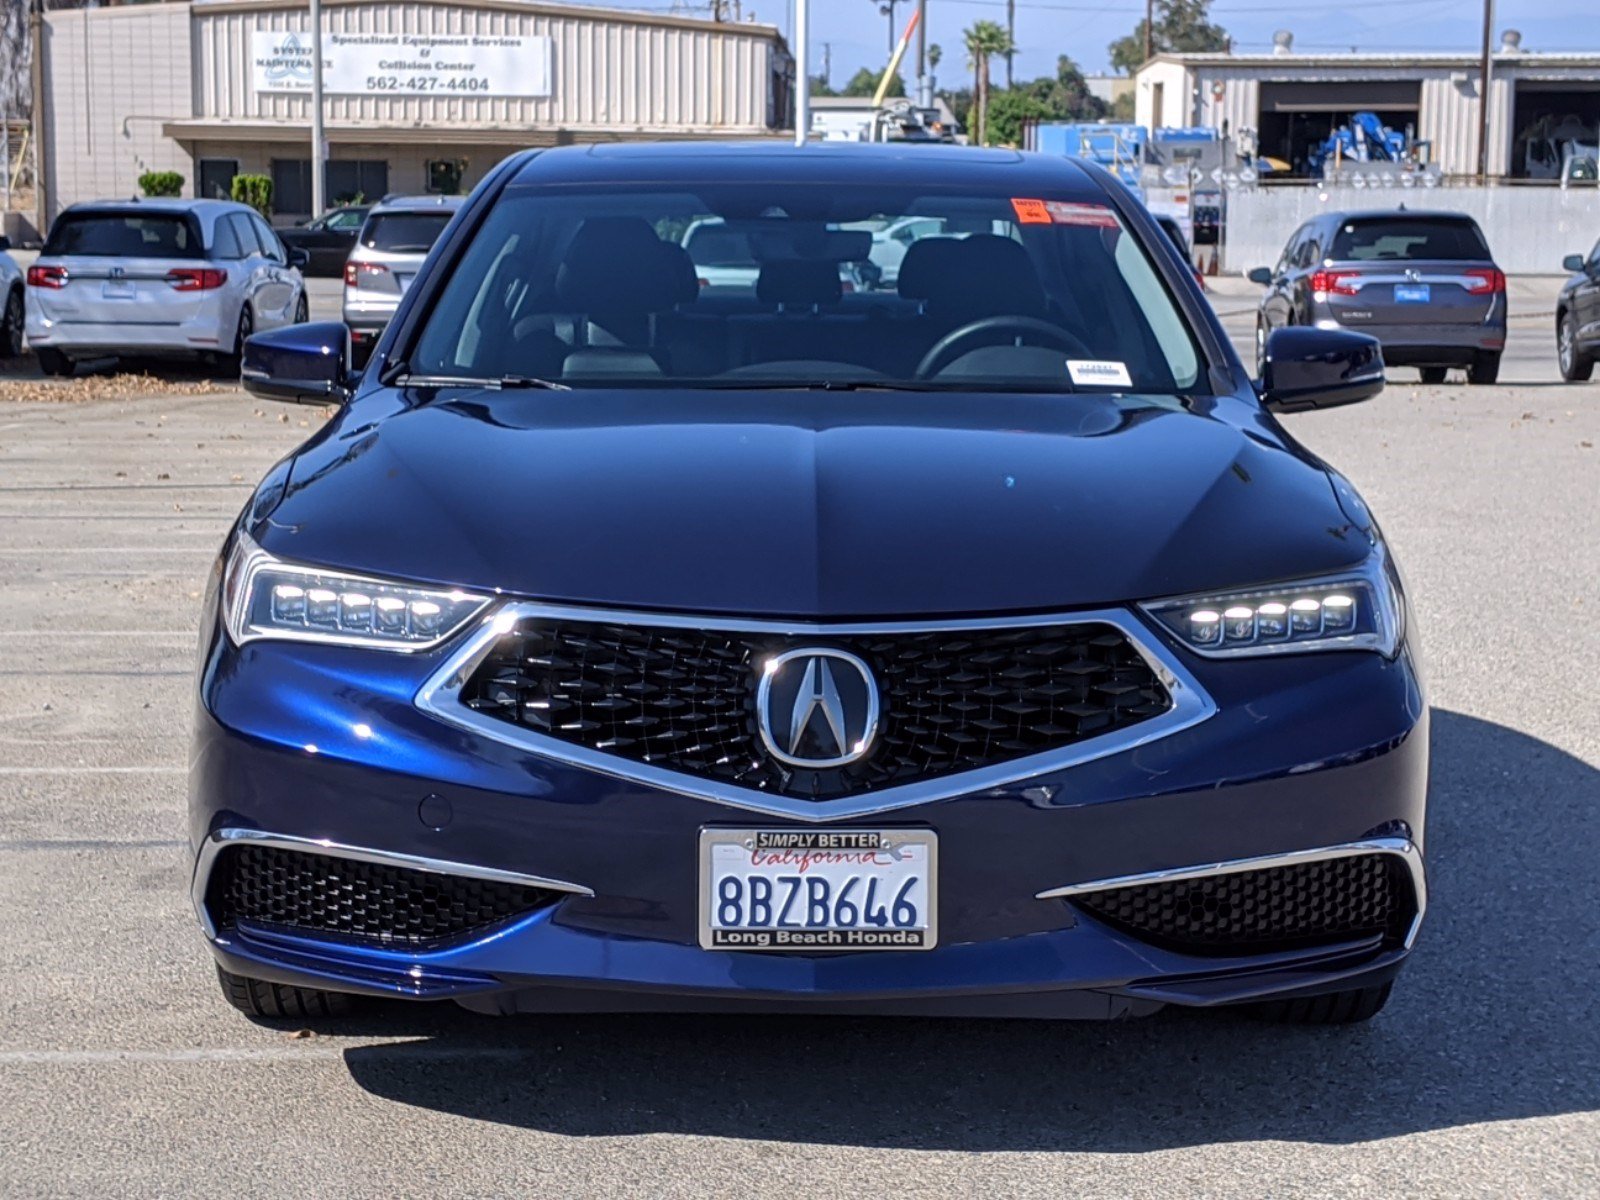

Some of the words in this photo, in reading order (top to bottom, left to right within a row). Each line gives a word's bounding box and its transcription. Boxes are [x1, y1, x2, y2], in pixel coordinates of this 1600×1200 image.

[331, 35, 398, 46] Specialized
[402, 36, 469, 47] Equipment
[472, 38, 522, 46] Services
[256, 58, 334, 68] MAINTENAE
[378, 60, 432, 70] Collision
[435, 61, 476, 71] Center
[366, 76, 490, 91] 562-427-4404
[758, 834, 816, 848] SIMPLY
[818, 834, 879, 848] BETTER
[750, 849, 892, 874] California
[717, 875, 919, 927] 8BZB646
[716, 930, 770, 945] Long
[776, 930, 842, 944] Beach
[847, 930, 920, 944] Honda
